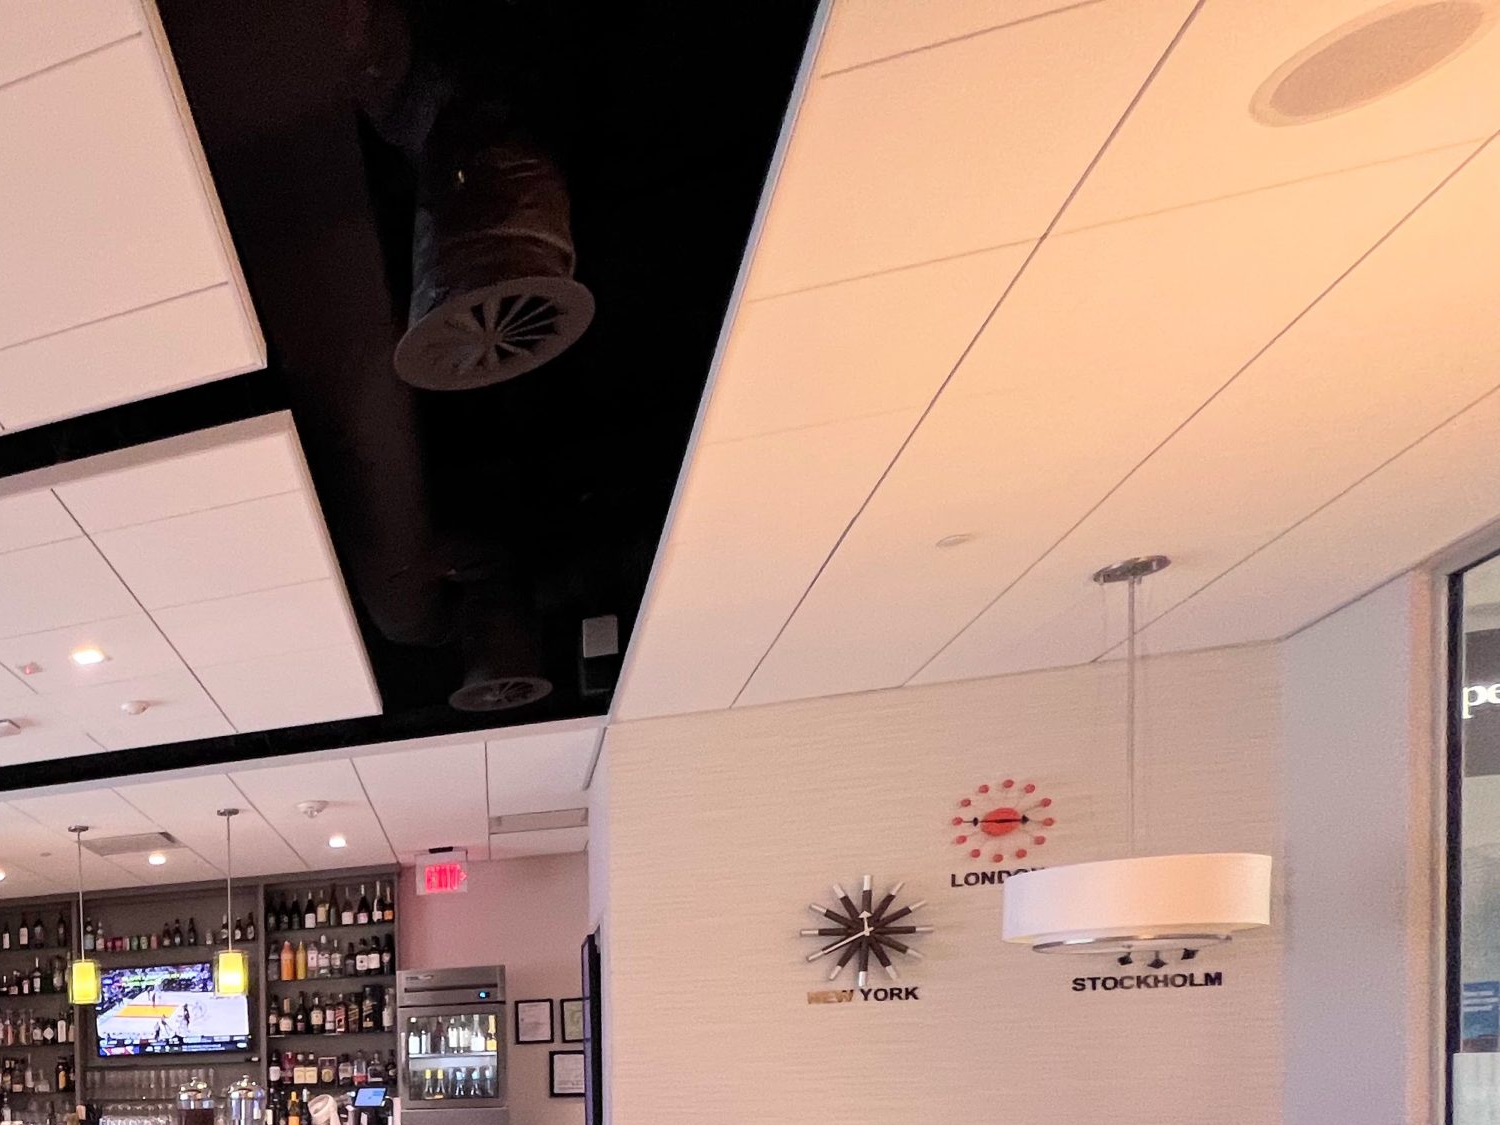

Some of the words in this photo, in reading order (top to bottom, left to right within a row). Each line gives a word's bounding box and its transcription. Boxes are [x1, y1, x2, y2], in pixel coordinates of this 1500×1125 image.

[425, 863, 460, 894] EXIT
[950, 867, 1046, 888] LOND
[1071, 971, 1223, 992] STOCKHOLM
[807, 989, 854, 1005] NEW
[859, 986, 920, 1002] YORK
